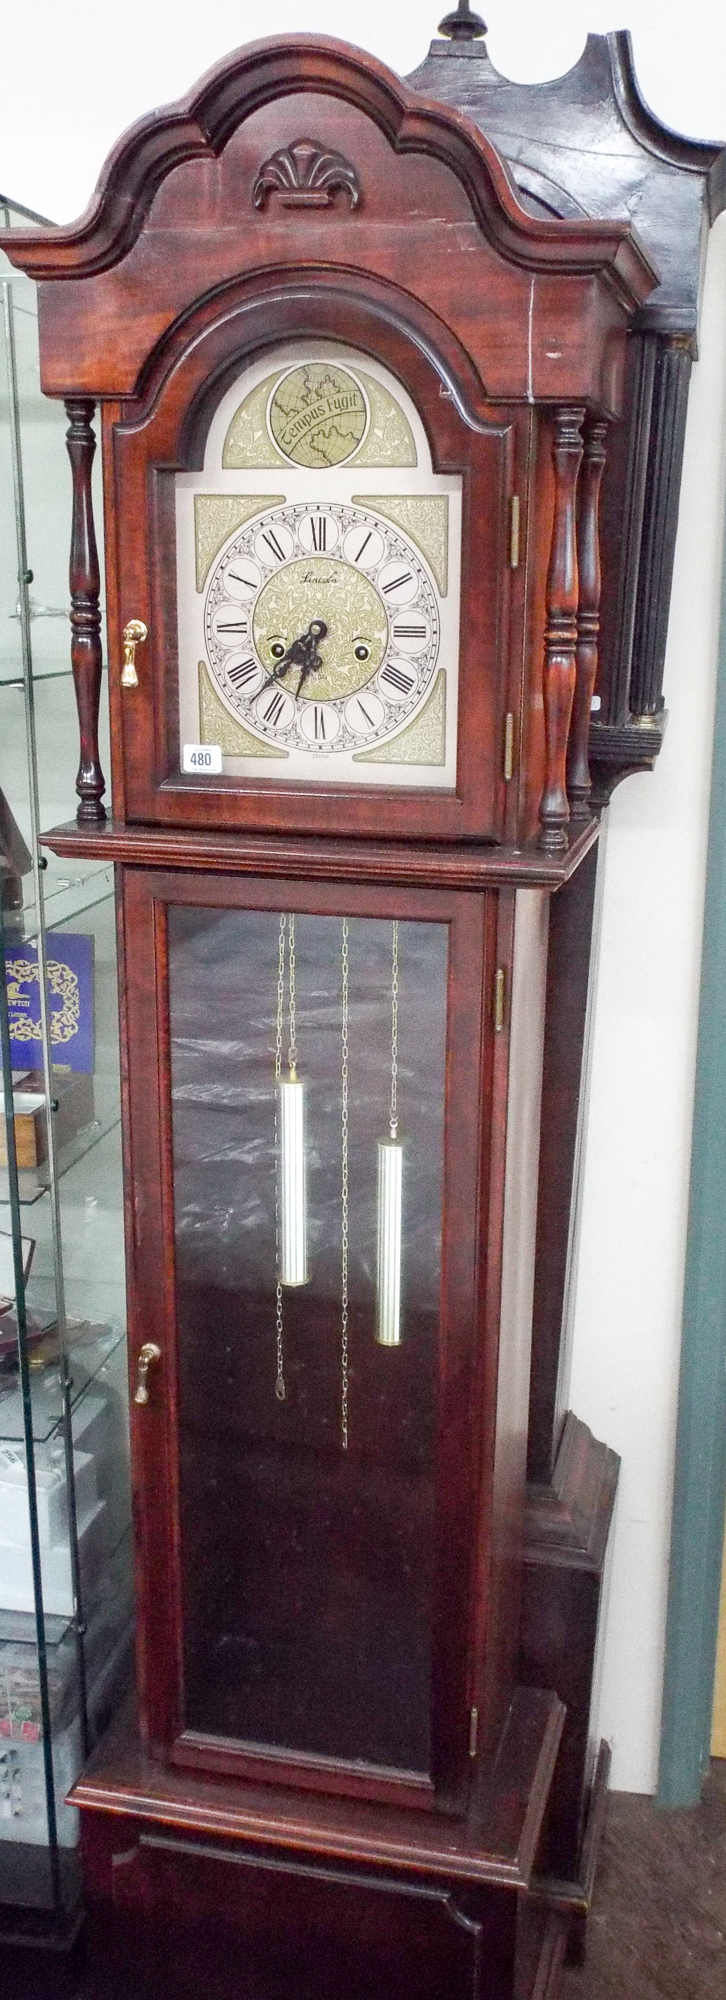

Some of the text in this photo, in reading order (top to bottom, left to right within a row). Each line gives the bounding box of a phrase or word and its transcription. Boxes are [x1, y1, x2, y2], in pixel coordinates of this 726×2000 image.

[281, 393, 358, 445] Tempus Fugit
[262, 530, 287, 564] XI
[310, 517, 327, 551] XII
[354, 532, 373, 563] I
[228, 569, 258, 593] X
[382, 572, 413, 594] II
[217, 620, 247, 633] IX
[394, 626, 426, 638] III
[227, 658, 260, 690] VIII
[381, 663, 415, 695] IIII
[263, 692, 287, 726] VII
[314, 706, 326, 740] VI
[356, 698, 375, 728] V
[190, 752, 212, 766] 480
